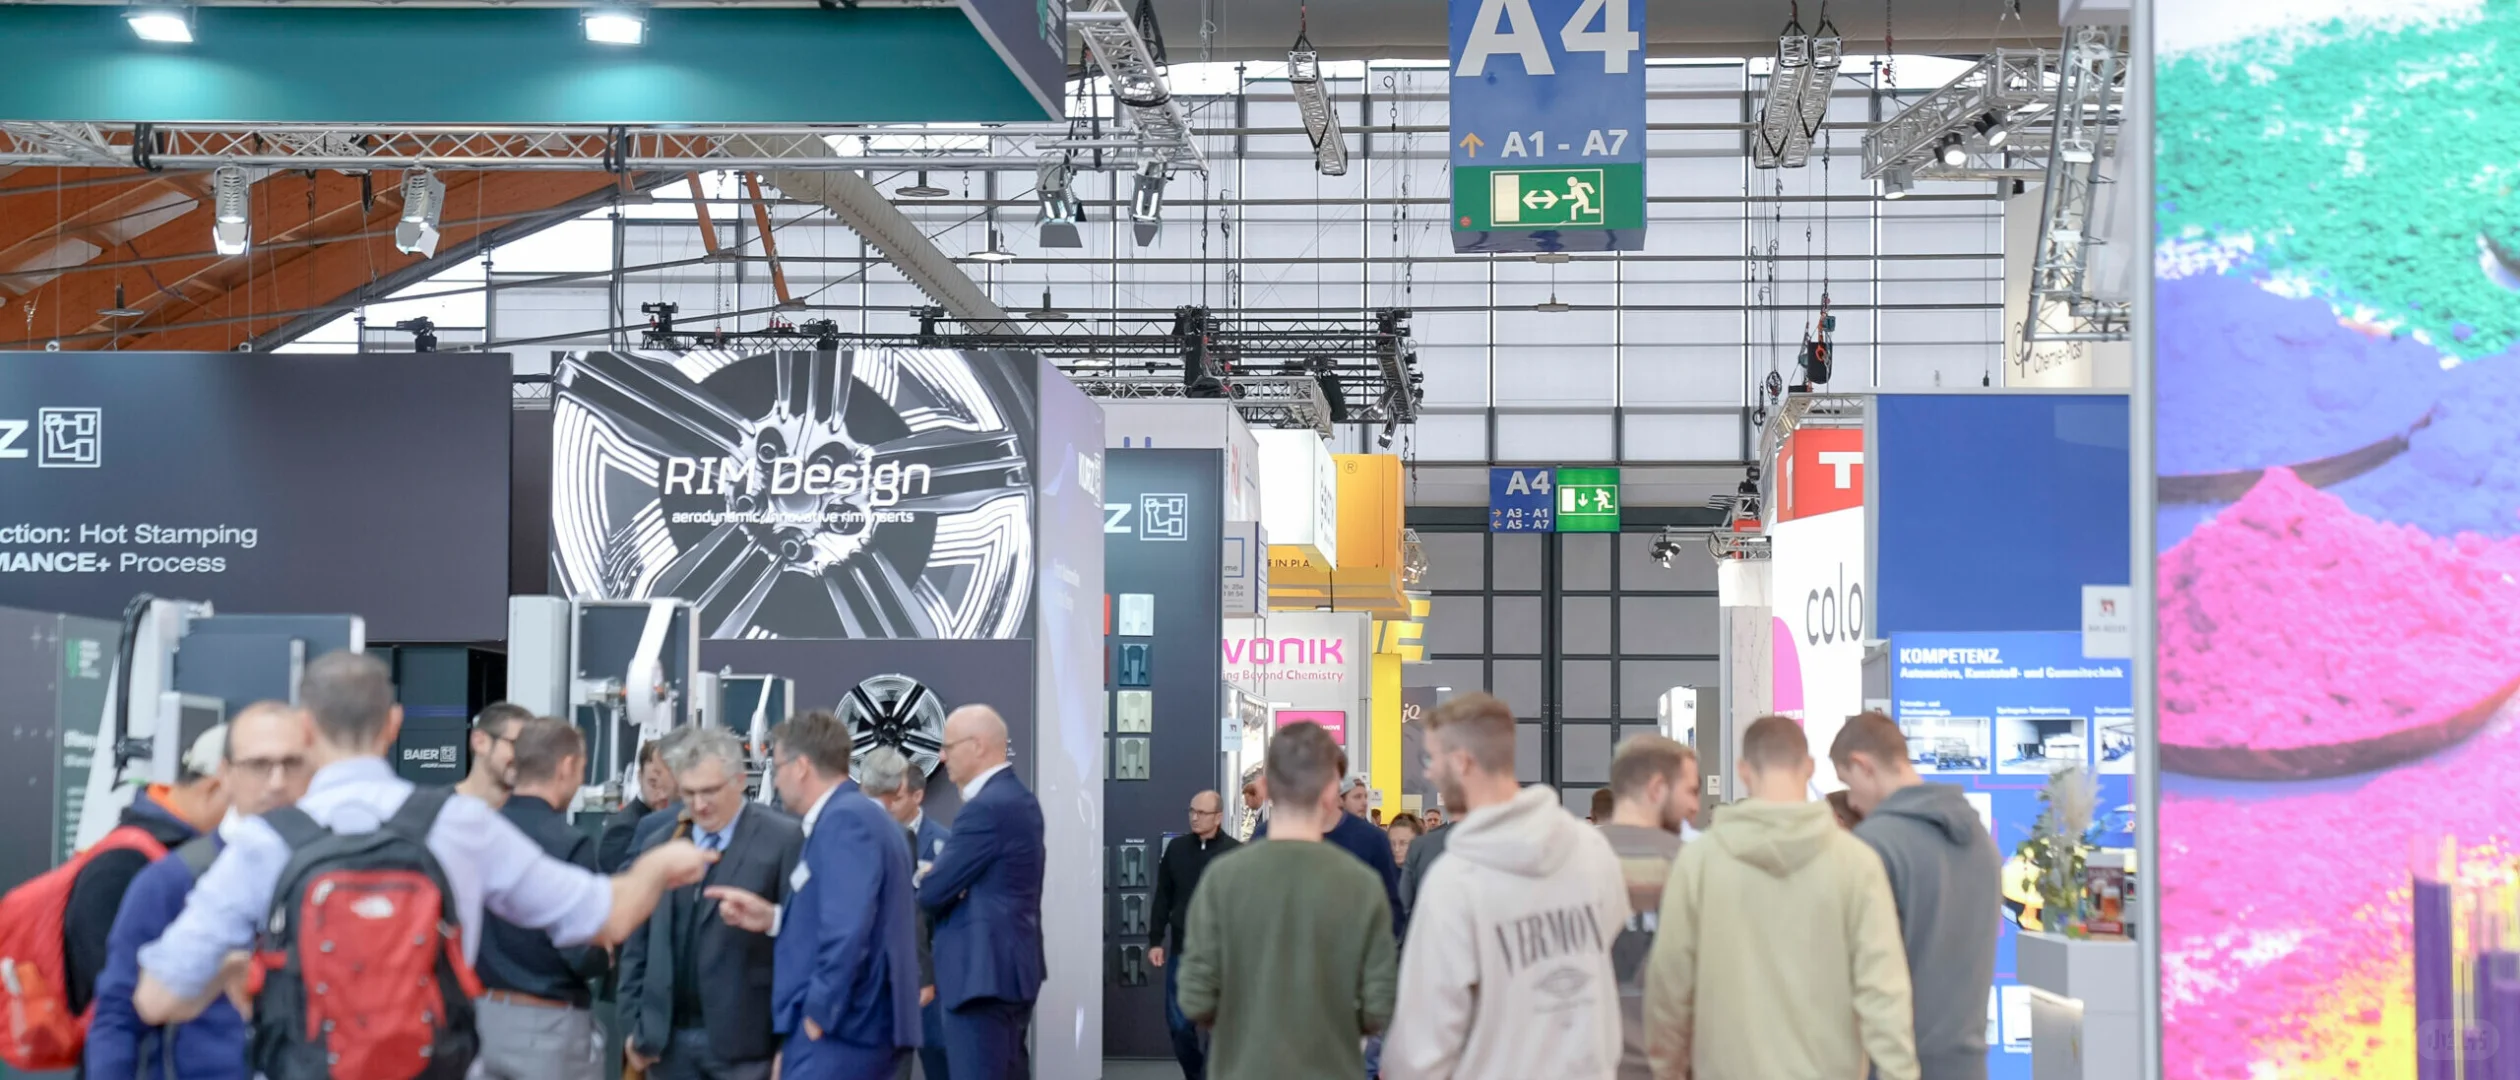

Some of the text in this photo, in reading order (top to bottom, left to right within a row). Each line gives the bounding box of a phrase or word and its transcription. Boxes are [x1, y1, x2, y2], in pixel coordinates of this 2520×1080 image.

[1455, 0, 1640, 77] A4
[1501, 131, 1544, 158] A1
[1582, 129, 1628, 157] A7
[664, 455, 931, 507] RIM Design
[1505, 470, 1551, 495] A4
[1506, 508, 1522, 518] A3
[1533, 508, 1548, 518] A1
[80, 523, 128, 545] Hot
[135, 523, 258, 548] Stamping
[1506, 520, 1522, 530] A5
[1533, 520, 1550, 530] A7
[120, 552, 226, 573] Process
[1900, 648, 2003, 664] KOMPETENZ.
[1243, 670, 1283, 682] Beyond
[1286, 670, 1344, 682] Chemistry
[403, 749, 439, 760] BAIER
